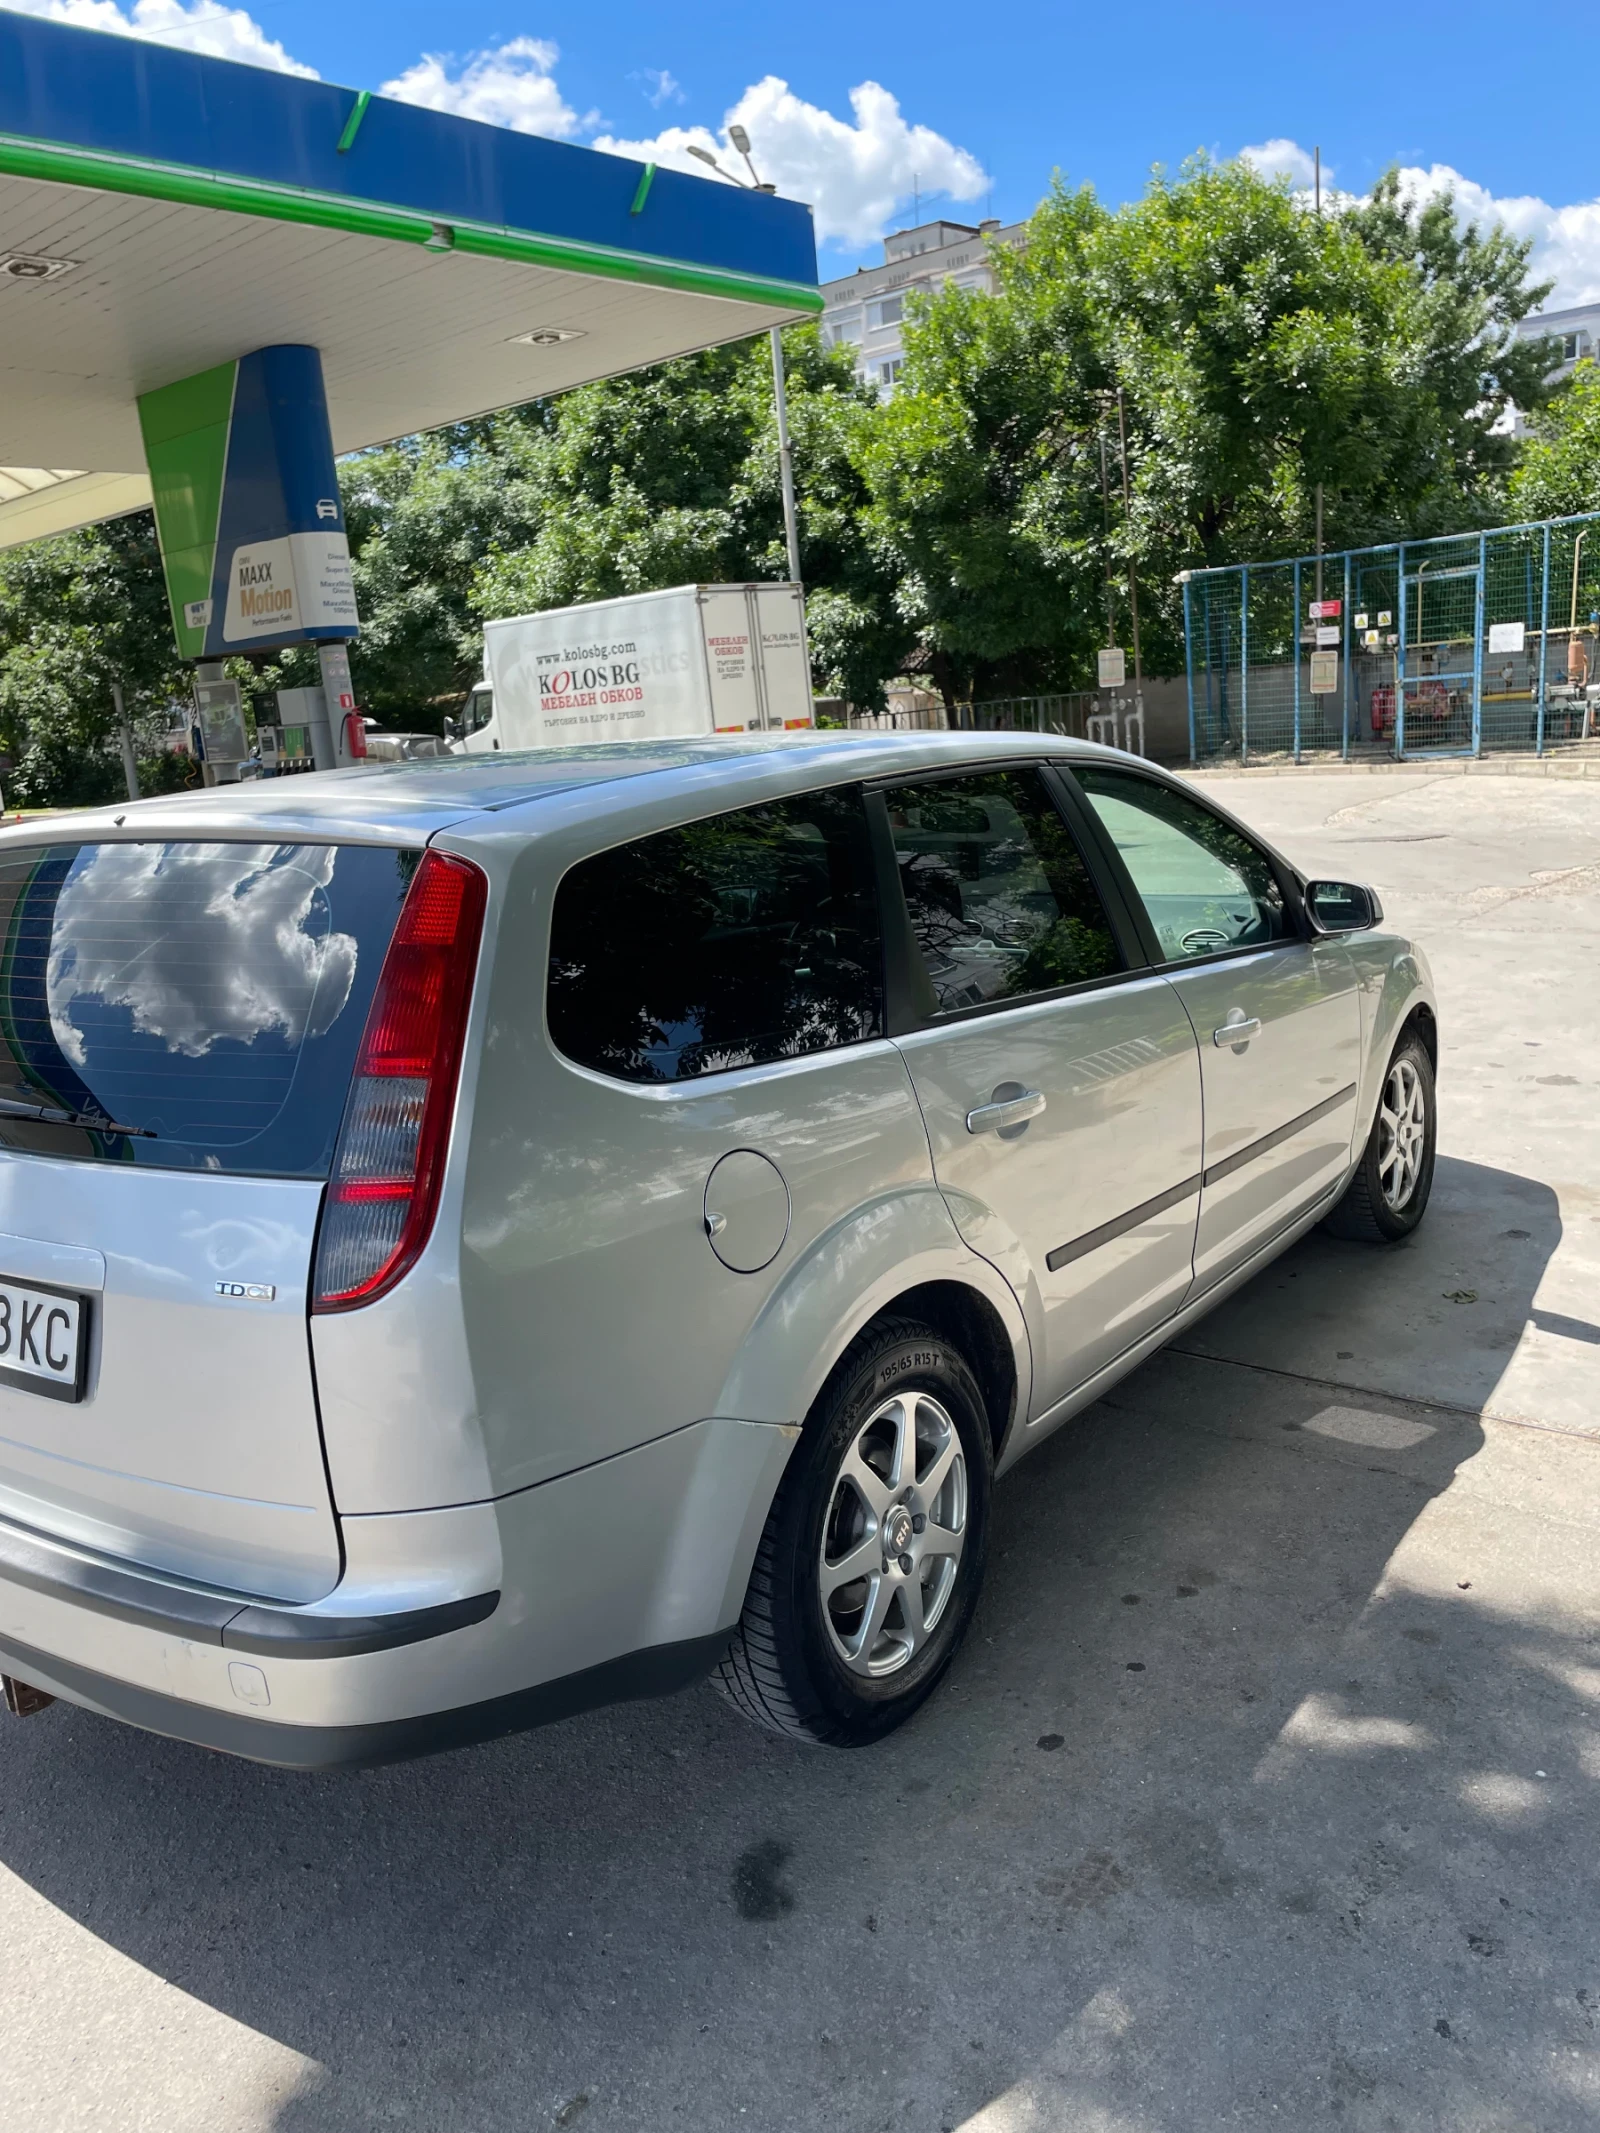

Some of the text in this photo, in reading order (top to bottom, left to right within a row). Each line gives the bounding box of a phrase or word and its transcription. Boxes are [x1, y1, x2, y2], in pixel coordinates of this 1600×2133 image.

[239, 562, 272, 587] MAXX
[240, 584, 292, 617] Motion
[708, 635, 748, 646] МЕБЕЛЕН
[714, 646, 744, 656] ОБКОВ
[536, 642, 637, 666] www.kolosbg.com
[538, 666, 608, 695] KOLOS
[610, 662, 640, 686] BG
[541, 687, 643, 711] МЕБЕЛЕН ОБКОВ
[579, 715, 589, 724] НА
[881, 1353, 939, 1382] 195/65 R15 T
[895, 1519, 910, 1547] RH
